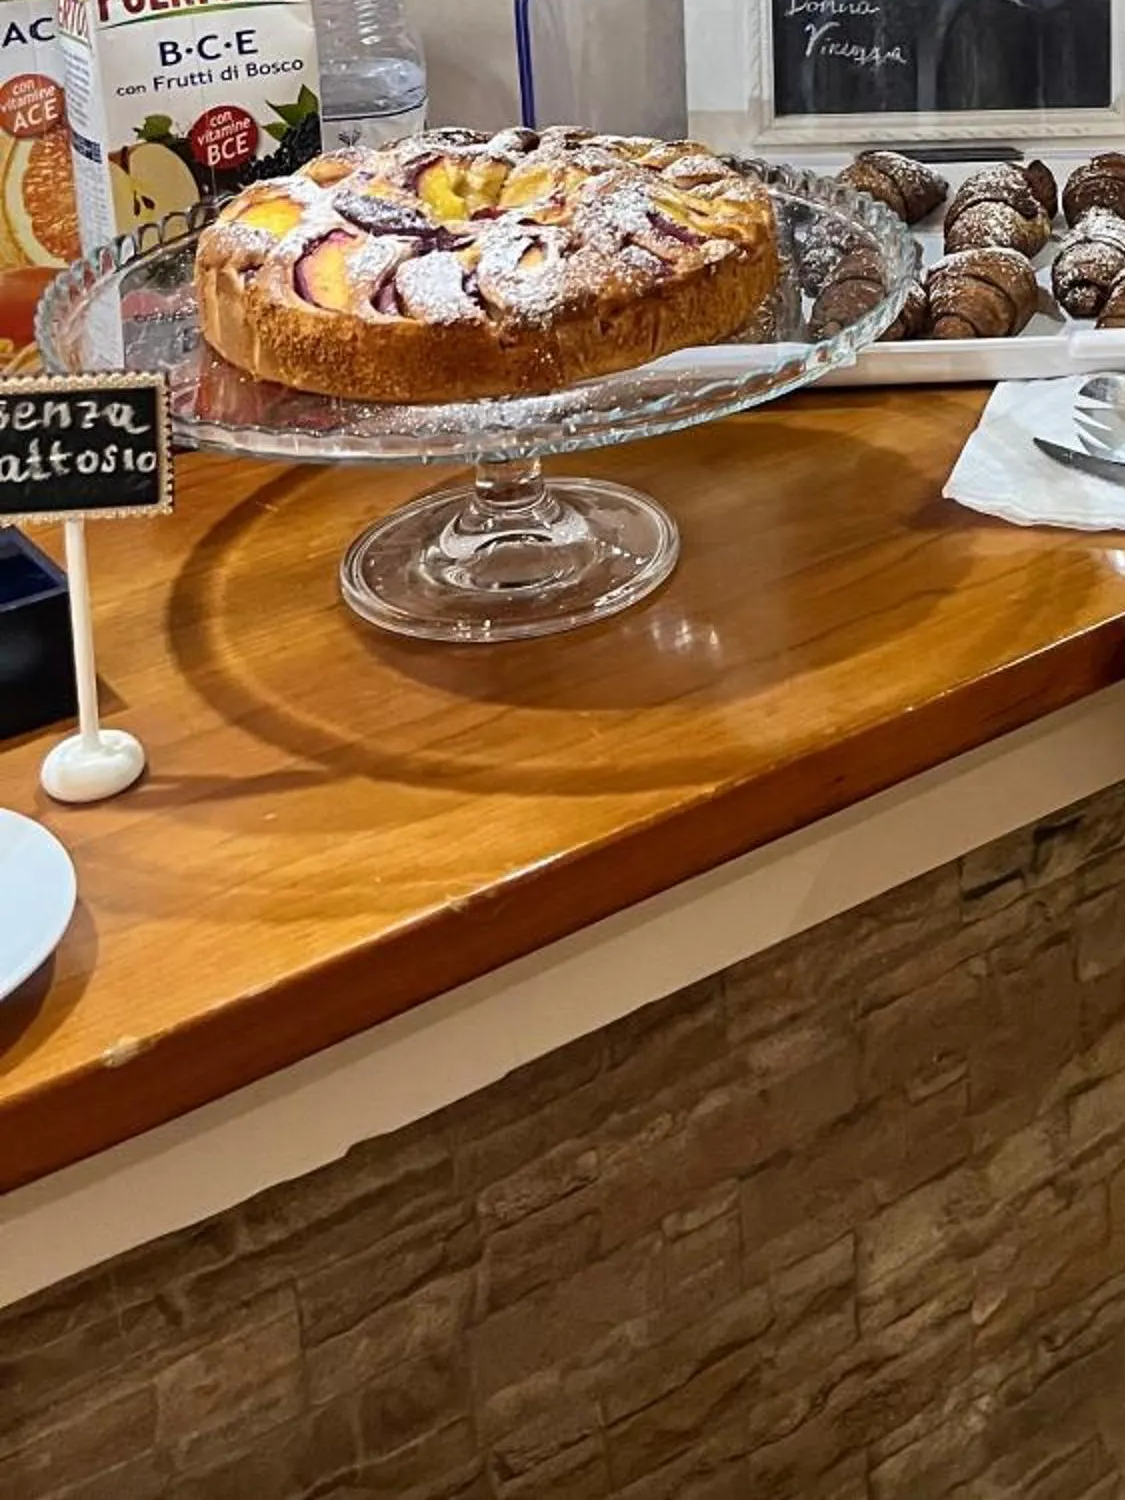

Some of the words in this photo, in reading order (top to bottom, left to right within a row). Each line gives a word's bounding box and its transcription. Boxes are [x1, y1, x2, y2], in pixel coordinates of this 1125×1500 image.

[12, 79, 36, 97] con
[116, 83, 147, 98] con
[153, 69, 214, 93] Frutti
[220, 65, 239, 82] di
[246, 58, 304, 79] Bosco
[13, 97, 59, 133] ACE
[197, 116, 251, 146] vitamine
[209, 109, 233, 128] con
[206, 131, 250, 167] BCE
[0, 437, 158, 483] attosio
